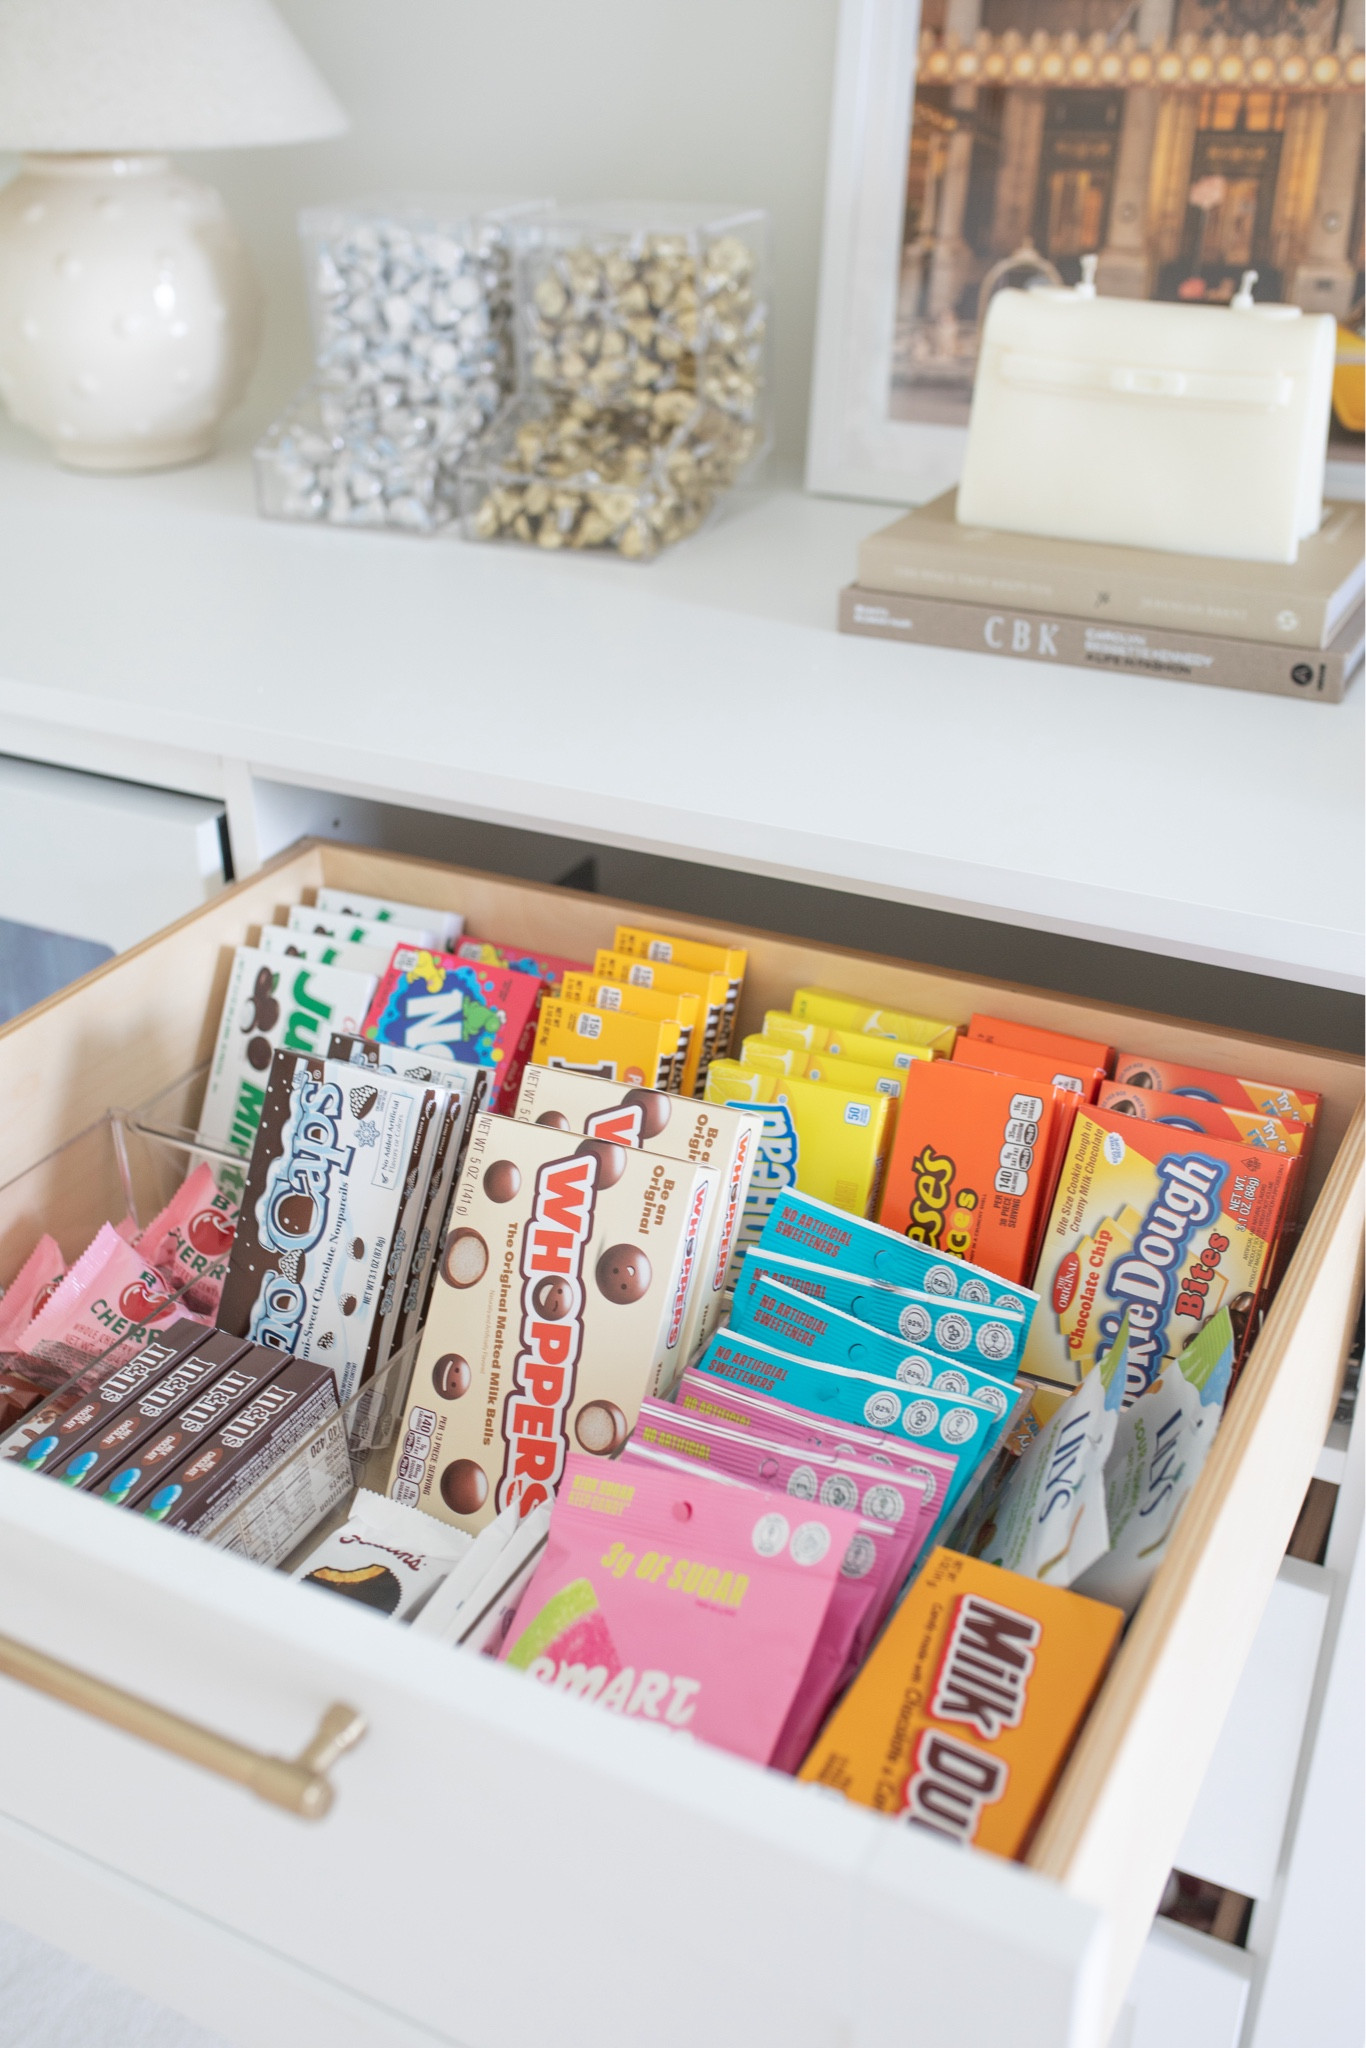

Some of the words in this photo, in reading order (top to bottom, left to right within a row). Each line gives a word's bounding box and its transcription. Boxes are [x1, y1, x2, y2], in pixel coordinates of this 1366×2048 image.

[587, 1017, 601, 1038] 150
[528, 1069, 542, 1086] NET
[523, 1088, 536, 1105] WT
[389, 1100, 400, 1133] Artificial
[847, 1106, 861, 1121] 50
[1082, 1120, 1094, 1131] in
[477, 1116, 493, 1137] NET
[705, 1127, 719, 1149] Be
[384, 1133, 393, 1156] Added
[472, 1136, 487, 1154] WT
[1073, 1131, 1093, 1163] Dough
[1082, 1127, 1106, 1174] Chocolate
[382, 1160, 389, 1171] No
[471, 1156, 481, 1164] 5
[466, 1165, 481, 1180] OZ
[998, 1170, 1013, 1189] 140
[1065, 1162, 1084, 1195] Cookie
[662, 1178, 675, 1201] Be
[1078, 1174, 1093, 1196] Milk
[638, 1165, 665, 1235] Original
[713, 1134, 749, 1290] WHOPPERS
[993, 1194, 1003, 1208] PER
[1000, 1196, 1012, 1216] PIECE
[1060, 1195, 1075, 1216] Size
[1228, 1192, 1242, 1212] NET
[1234, 1215, 1248, 1233] 3.1
[1243, 1176, 1261, 1201] (88g)
[654, 1203, 667, 1225] an
[1007, 1198, 1021, 1228] SERVING
[1054, 1215, 1069, 1235] Bite
[1068, 1196, 1088, 1232] Creamy
[506, 1221, 518, 1249] The
[781, 1206, 795, 1223] NO
[796, 1213, 853, 1247] ARTIFICIAL
[1111, 1160, 1218, 1305] Dough
[312, 1246, 337, 1302] Chocolate
[329, 1181, 349, 1246] Nonpareils
[372, 1235, 386, 1259] (87.8g)
[775, 1220, 841, 1258] SWEETENERS
[368, 1269, 377, 1279] 3.1
[370, 1259, 379, 1268] OZ
[667, 1187, 705, 1347] WHOPPERS
[365, 1279, 375, 1291] WT
[498, 1250, 515, 1313] Original
[932, 1278, 950, 1290] 92%
[1056, 1274, 1065, 1291] THE
[1058, 1259, 1080, 1309] ORIGINAL
[1176, 1232, 1230, 1321] Bites
[361, 1291, 372, 1304] NET
[1069, 1270, 1101, 1350] Chocolate
[1088, 1229, 1114, 1268] Chip
[759, 1294, 773, 1312] NO
[775, 1297, 829, 1337] ARTIFICIAL
[907, 1319, 922, 1329] 92%
[987, 1323, 1009, 1332] PLANT
[753, 1309, 817, 1347] SWEETENERS
[490, 1314, 507, 1368] Malted
[506, 1163, 590, 1519] WHOPPERS
[707, 1359, 776, 1391] SWEETENERS
[714, 1345, 730, 1361] NO
[732, 1351, 789, 1382] ARTIFICIAL
[905, 1369, 921, 1380] 92%
[486, 1371, 501, 1405] Milk
[682, 1394, 699, 1411] NO
[874, 1404, 891, 1414] 92%
[954, 1409, 975, 1418] PLANT
[62, 1404, 95, 1430] CHOCOLATE
[420, 1414, 434, 1434] 140
[437, 1415, 448, 1431] PER
[483, 1407, 497, 1446] Balls
[101, 1419, 134, 1445] CHOCOLATE
[436, 1431, 444, 1442] 13
[642, 1426, 659, 1444] NO
[657, 1431, 711, 1462] ARTIFICIAL
[144, 1435, 176, 1461] CHOCOLATE
[310, 1439, 325, 1459] 420
[430, 1441, 442, 1465] PIECE
[185, 1451, 217, 1477] CHOCOLATE
[422, 1464, 436, 1496] SERVING
[319, 1472, 353, 1513] Nutrition
[601, 1541, 636, 1579] 3g
[635, 1550, 672, 1583] OF
[666, 1558, 750, 1609] SUGAR
[939, 1598, 1038, 1732] Milk
